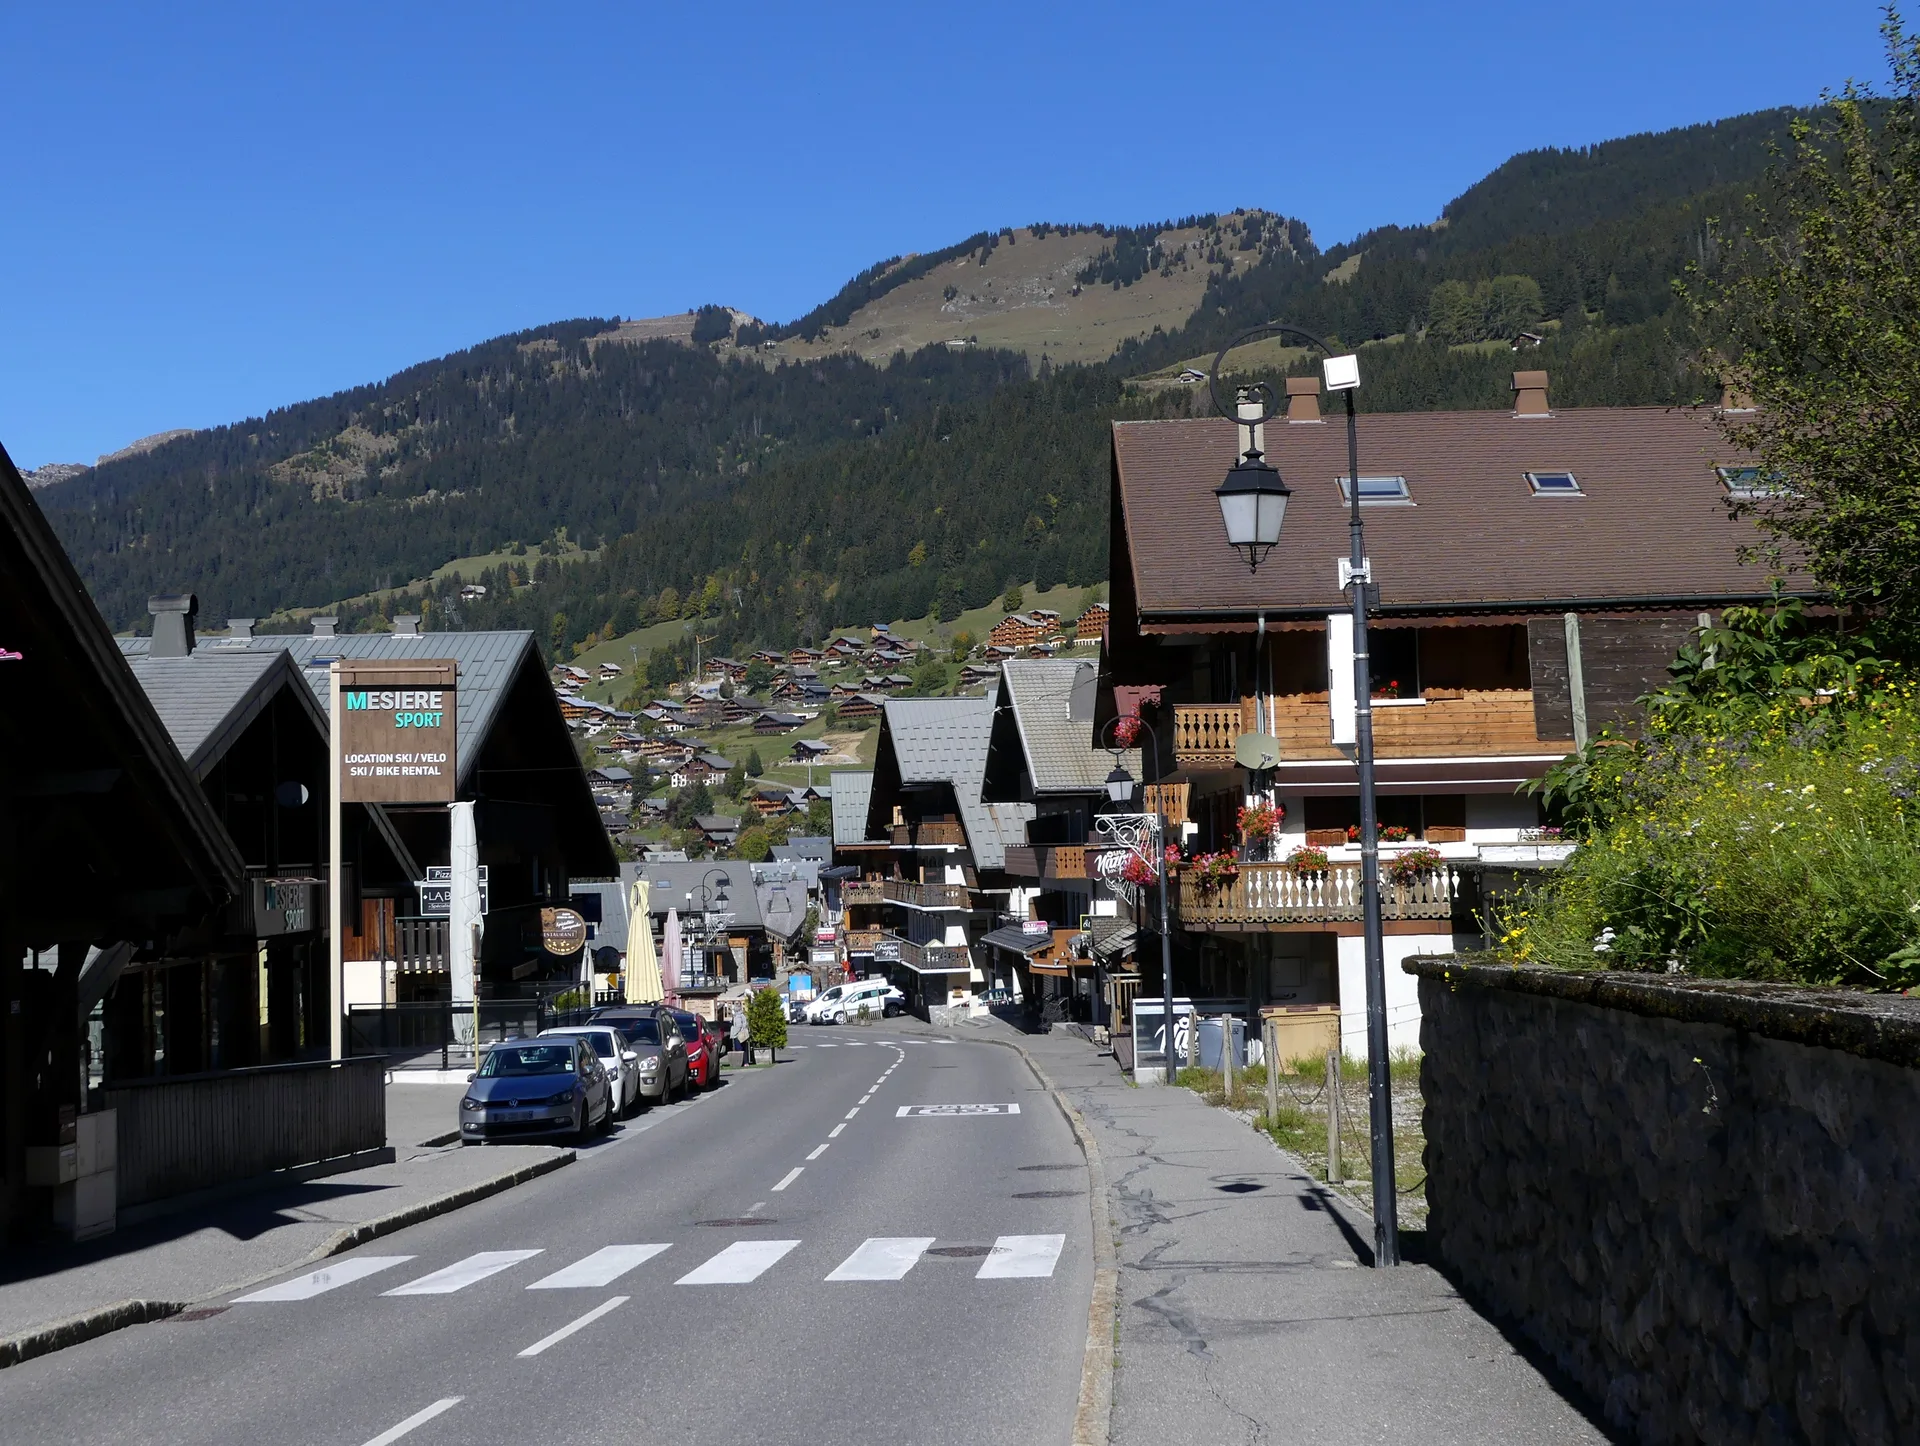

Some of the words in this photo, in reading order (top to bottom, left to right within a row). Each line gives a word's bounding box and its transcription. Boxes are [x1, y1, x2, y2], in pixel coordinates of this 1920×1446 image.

[347, 691, 443, 710] MESIERE
[395, 712, 443, 728] SPORT
[345, 754, 393, 764] LOCATION
[395, 754, 412, 763] SKI
[414, 754, 420, 764] /
[421, 753, 447, 763] VELO
[350, 767, 367, 776] SKI
[369, 767, 374, 776] /
[376, 767, 400, 776] BIKE
[402, 766, 441, 776] RENTAL
[435, 870, 451, 878] Pizz
[264, 885, 304, 911] MESIERE
[429, 891, 444, 902] LA
[285, 909, 304, 931] SPORT
